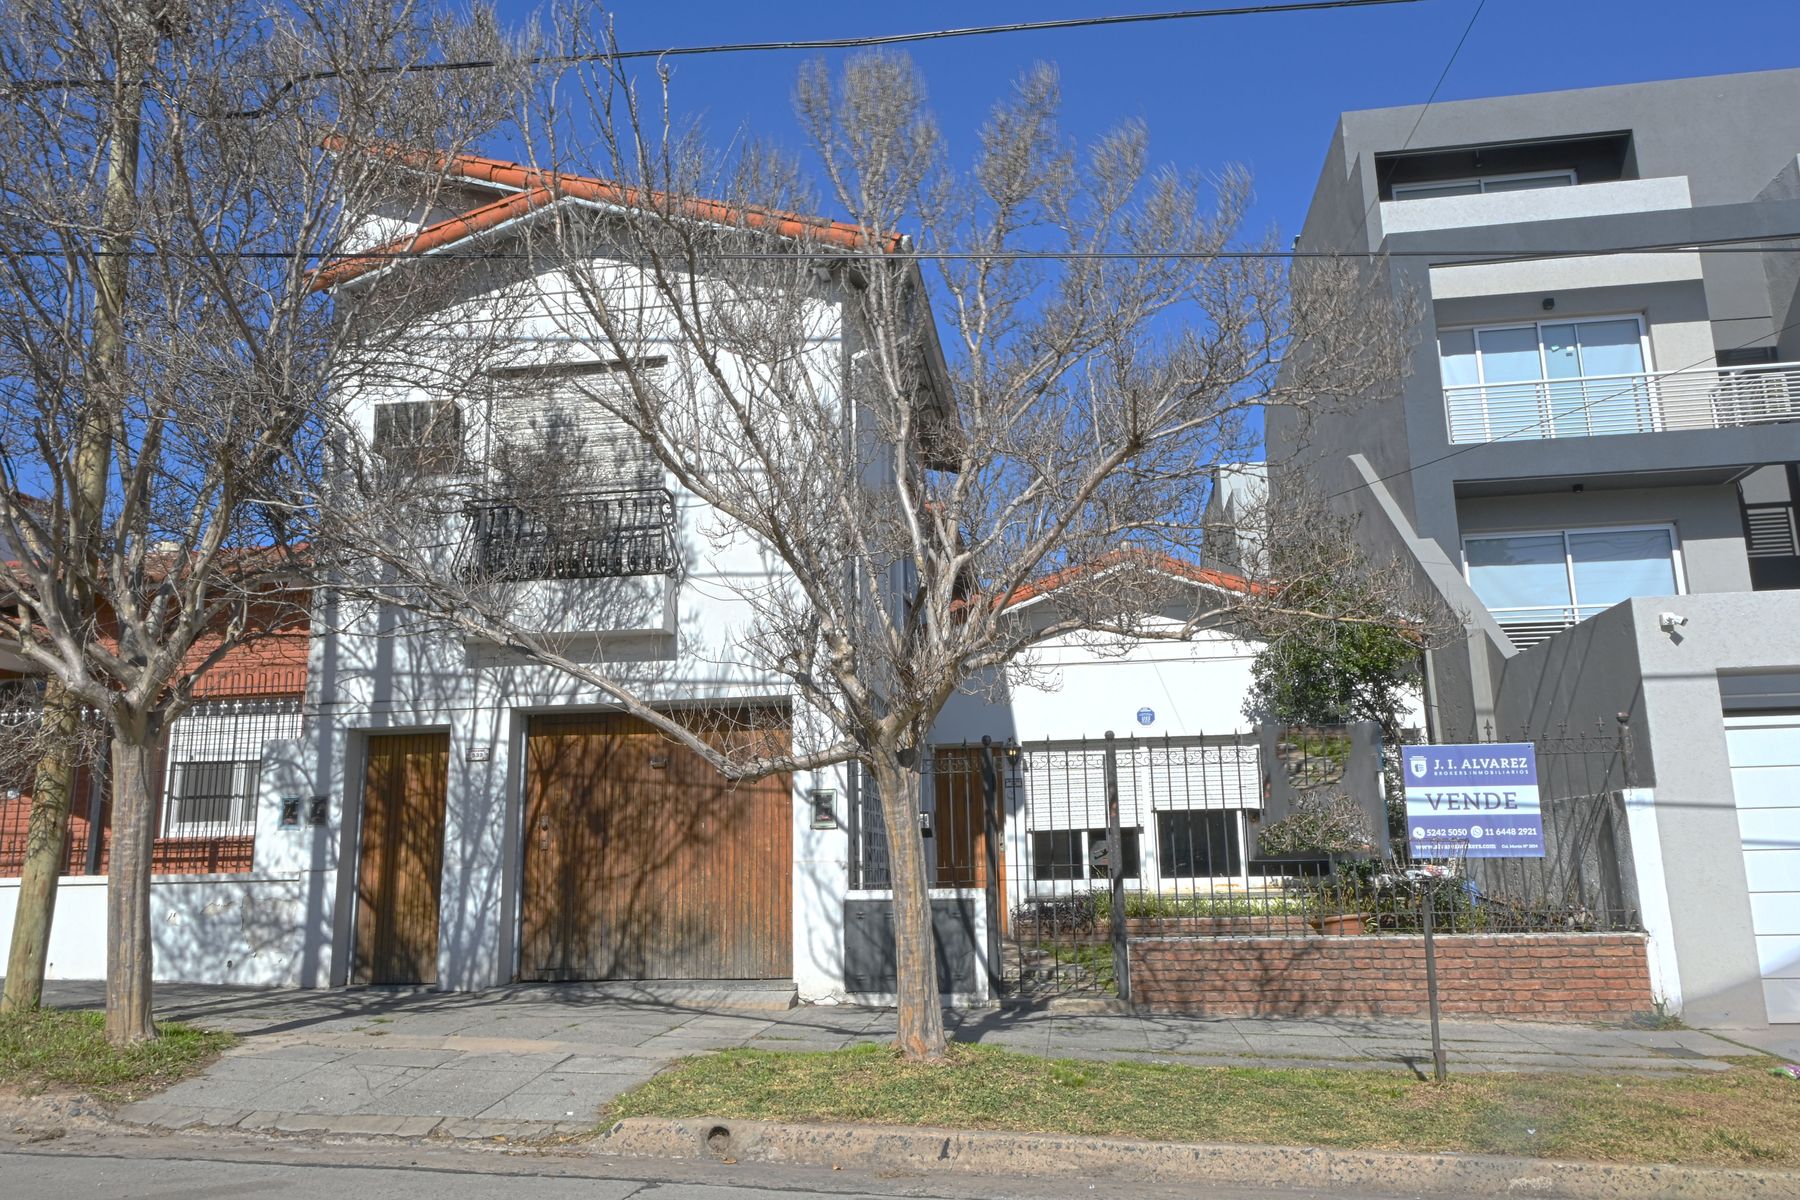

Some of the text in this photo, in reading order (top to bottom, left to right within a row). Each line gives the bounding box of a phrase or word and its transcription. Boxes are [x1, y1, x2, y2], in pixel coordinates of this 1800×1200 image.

[1434, 758, 1527, 770] J. I. ALVAREZ
[1425, 792, 1518, 810] VENDE
[1426, 828, 1468, 837] 5242 5050
[1485, 827, 1538, 836] 11 6448 2921
